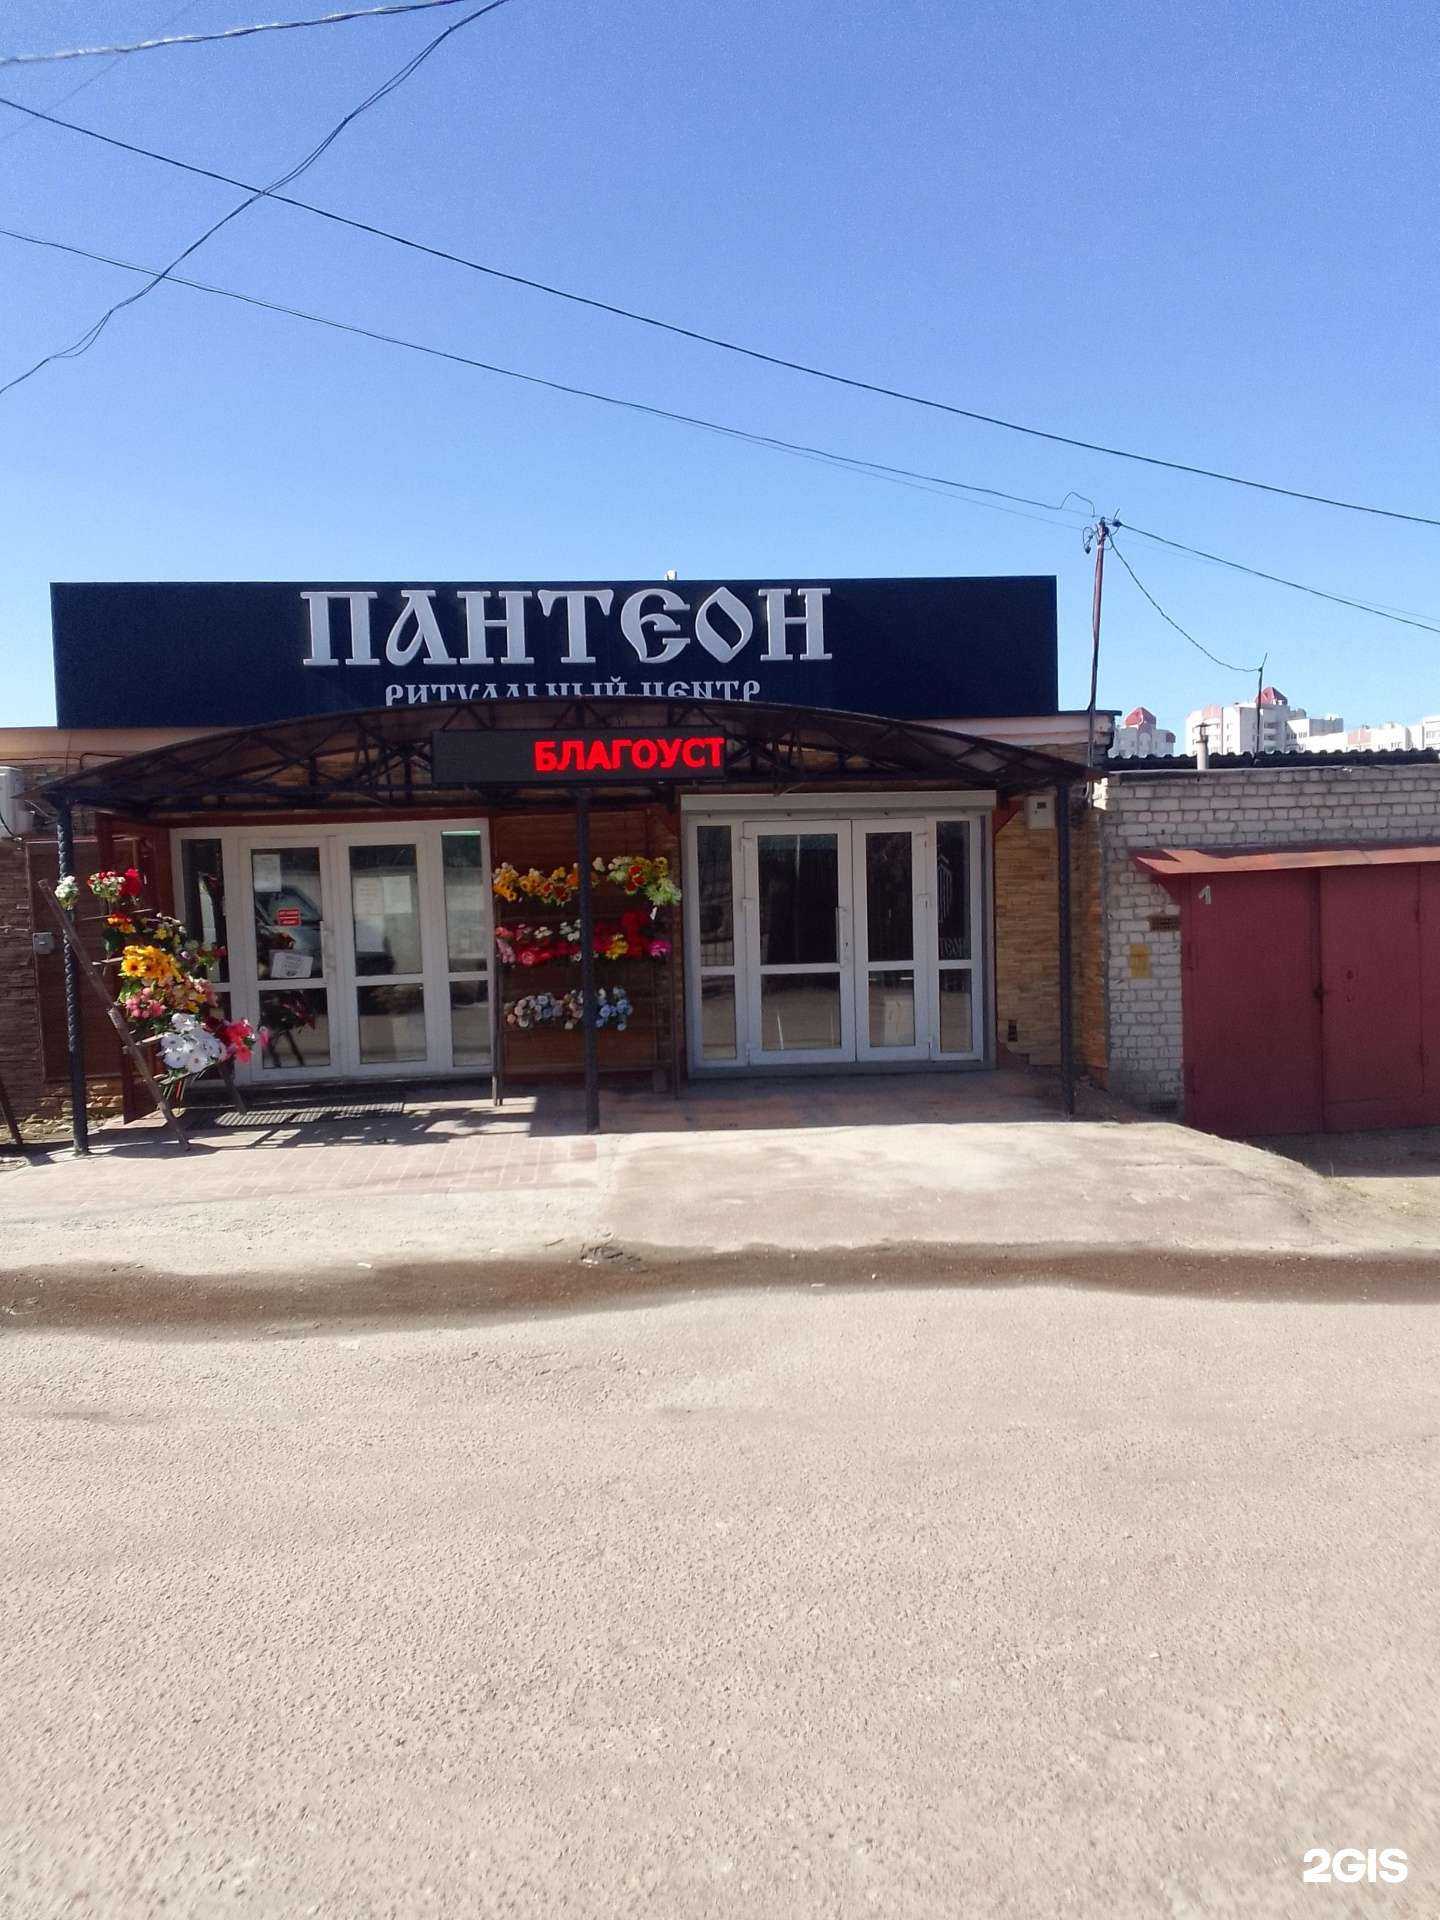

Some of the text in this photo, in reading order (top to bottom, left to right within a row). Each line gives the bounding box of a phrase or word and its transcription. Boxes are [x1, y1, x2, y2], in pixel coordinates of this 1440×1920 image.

[301, 586, 833, 666] ПАНТЕОН
[534, 737, 725, 772] БЛАГОУСТ
[1198, 885, 1212, 905] 1
